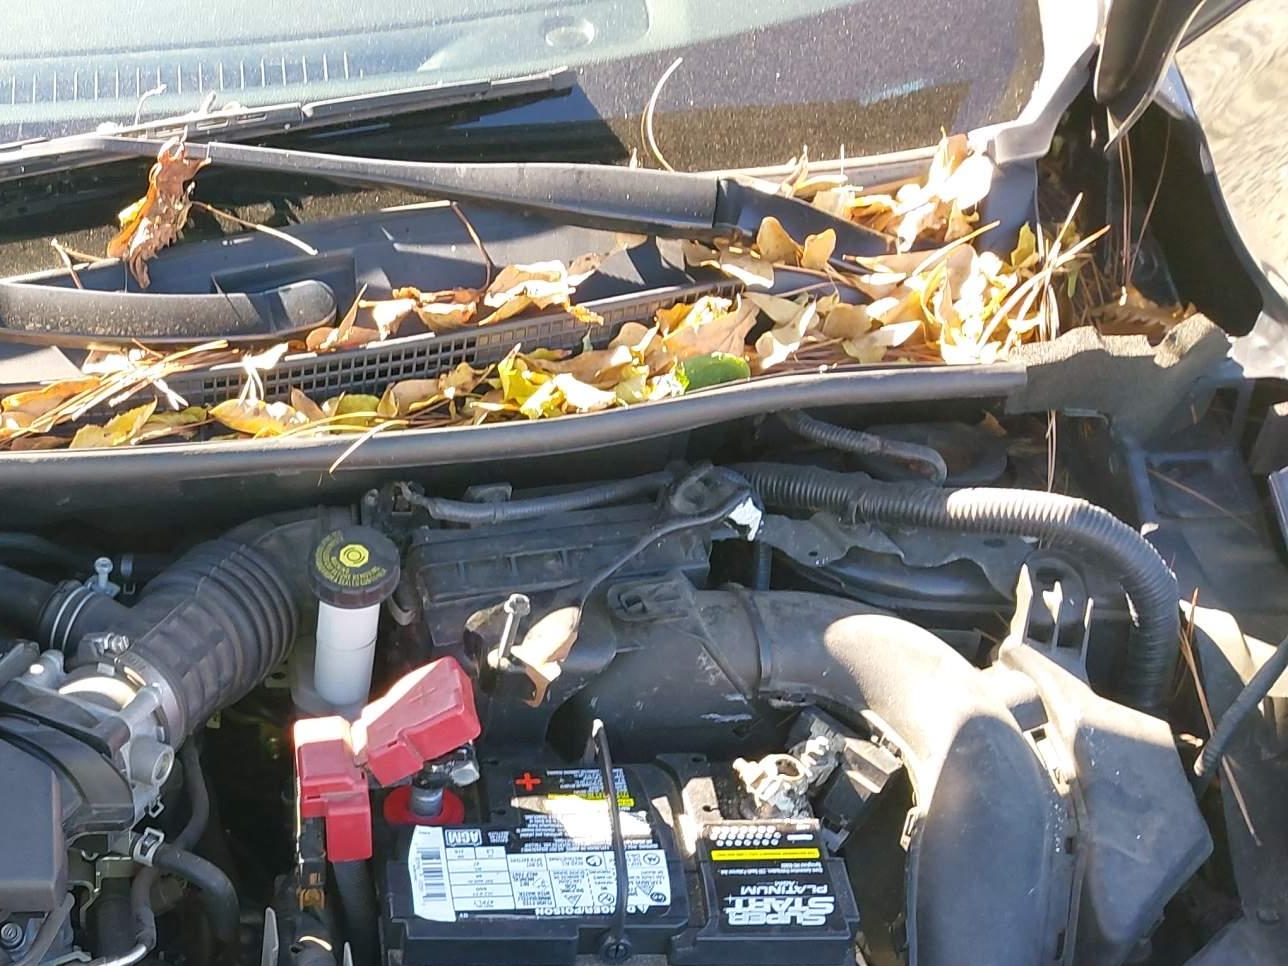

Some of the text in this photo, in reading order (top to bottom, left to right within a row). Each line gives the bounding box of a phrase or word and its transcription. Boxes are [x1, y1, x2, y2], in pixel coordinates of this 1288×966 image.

[740, 884, 828, 895] PLATINUM
[723, 896, 835, 914] START
[728, 911, 826, 926] SUPER
